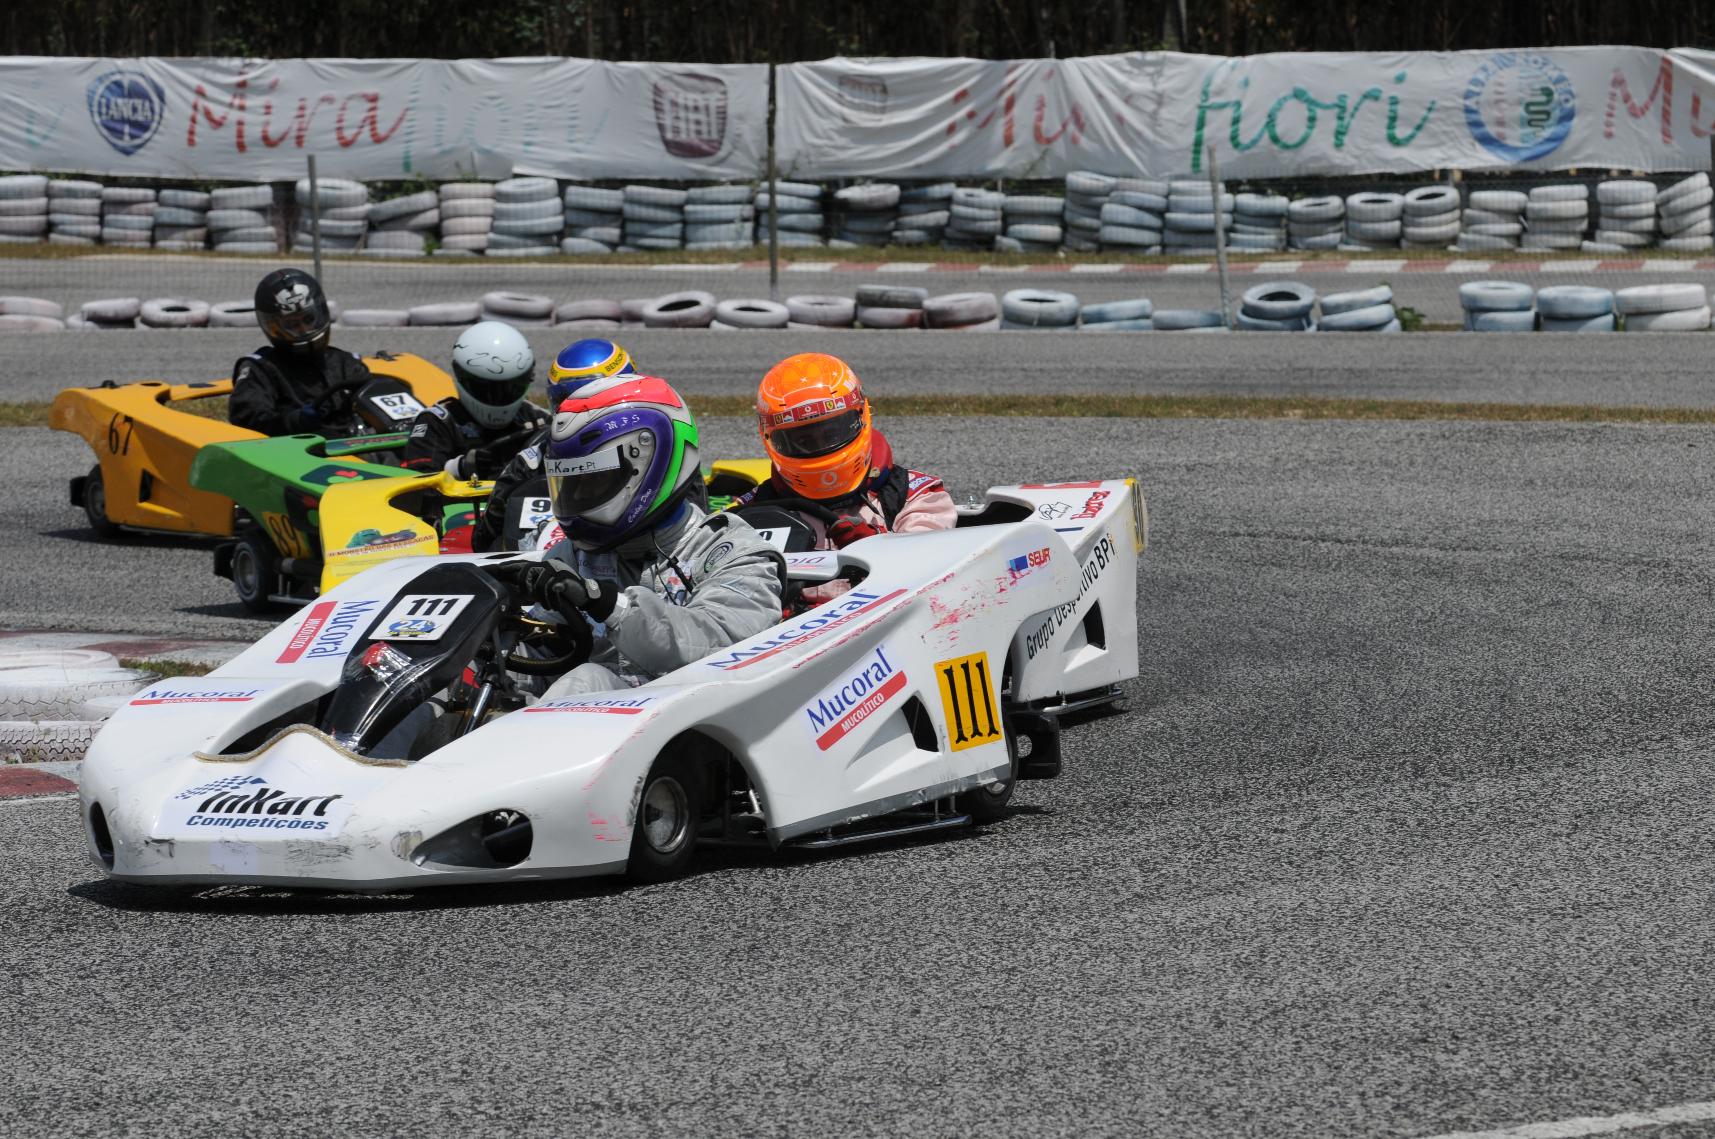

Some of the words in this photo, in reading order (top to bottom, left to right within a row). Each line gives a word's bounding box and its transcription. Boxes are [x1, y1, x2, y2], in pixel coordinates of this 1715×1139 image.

[100, 96, 153, 121] LANCIA
[1191, 59, 1436, 174] fiori
[380, 395, 406, 407] 67
[109, 412, 134, 456] 67
[1028, 547, 1051, 568] SEUR
[406, 598, 460, 616] 111
[306, 600, 380, 659] Mucoral
[706, 592, 880, 668] Mucoral
[1026, 616, 1055, 660] Grupo
[141, 689, 262, 699] Mucoral
[806, 647, 893, 734] Mucoral
[942, 659, 1000, 745] 111
[185, 815, 329, 831] Competições
